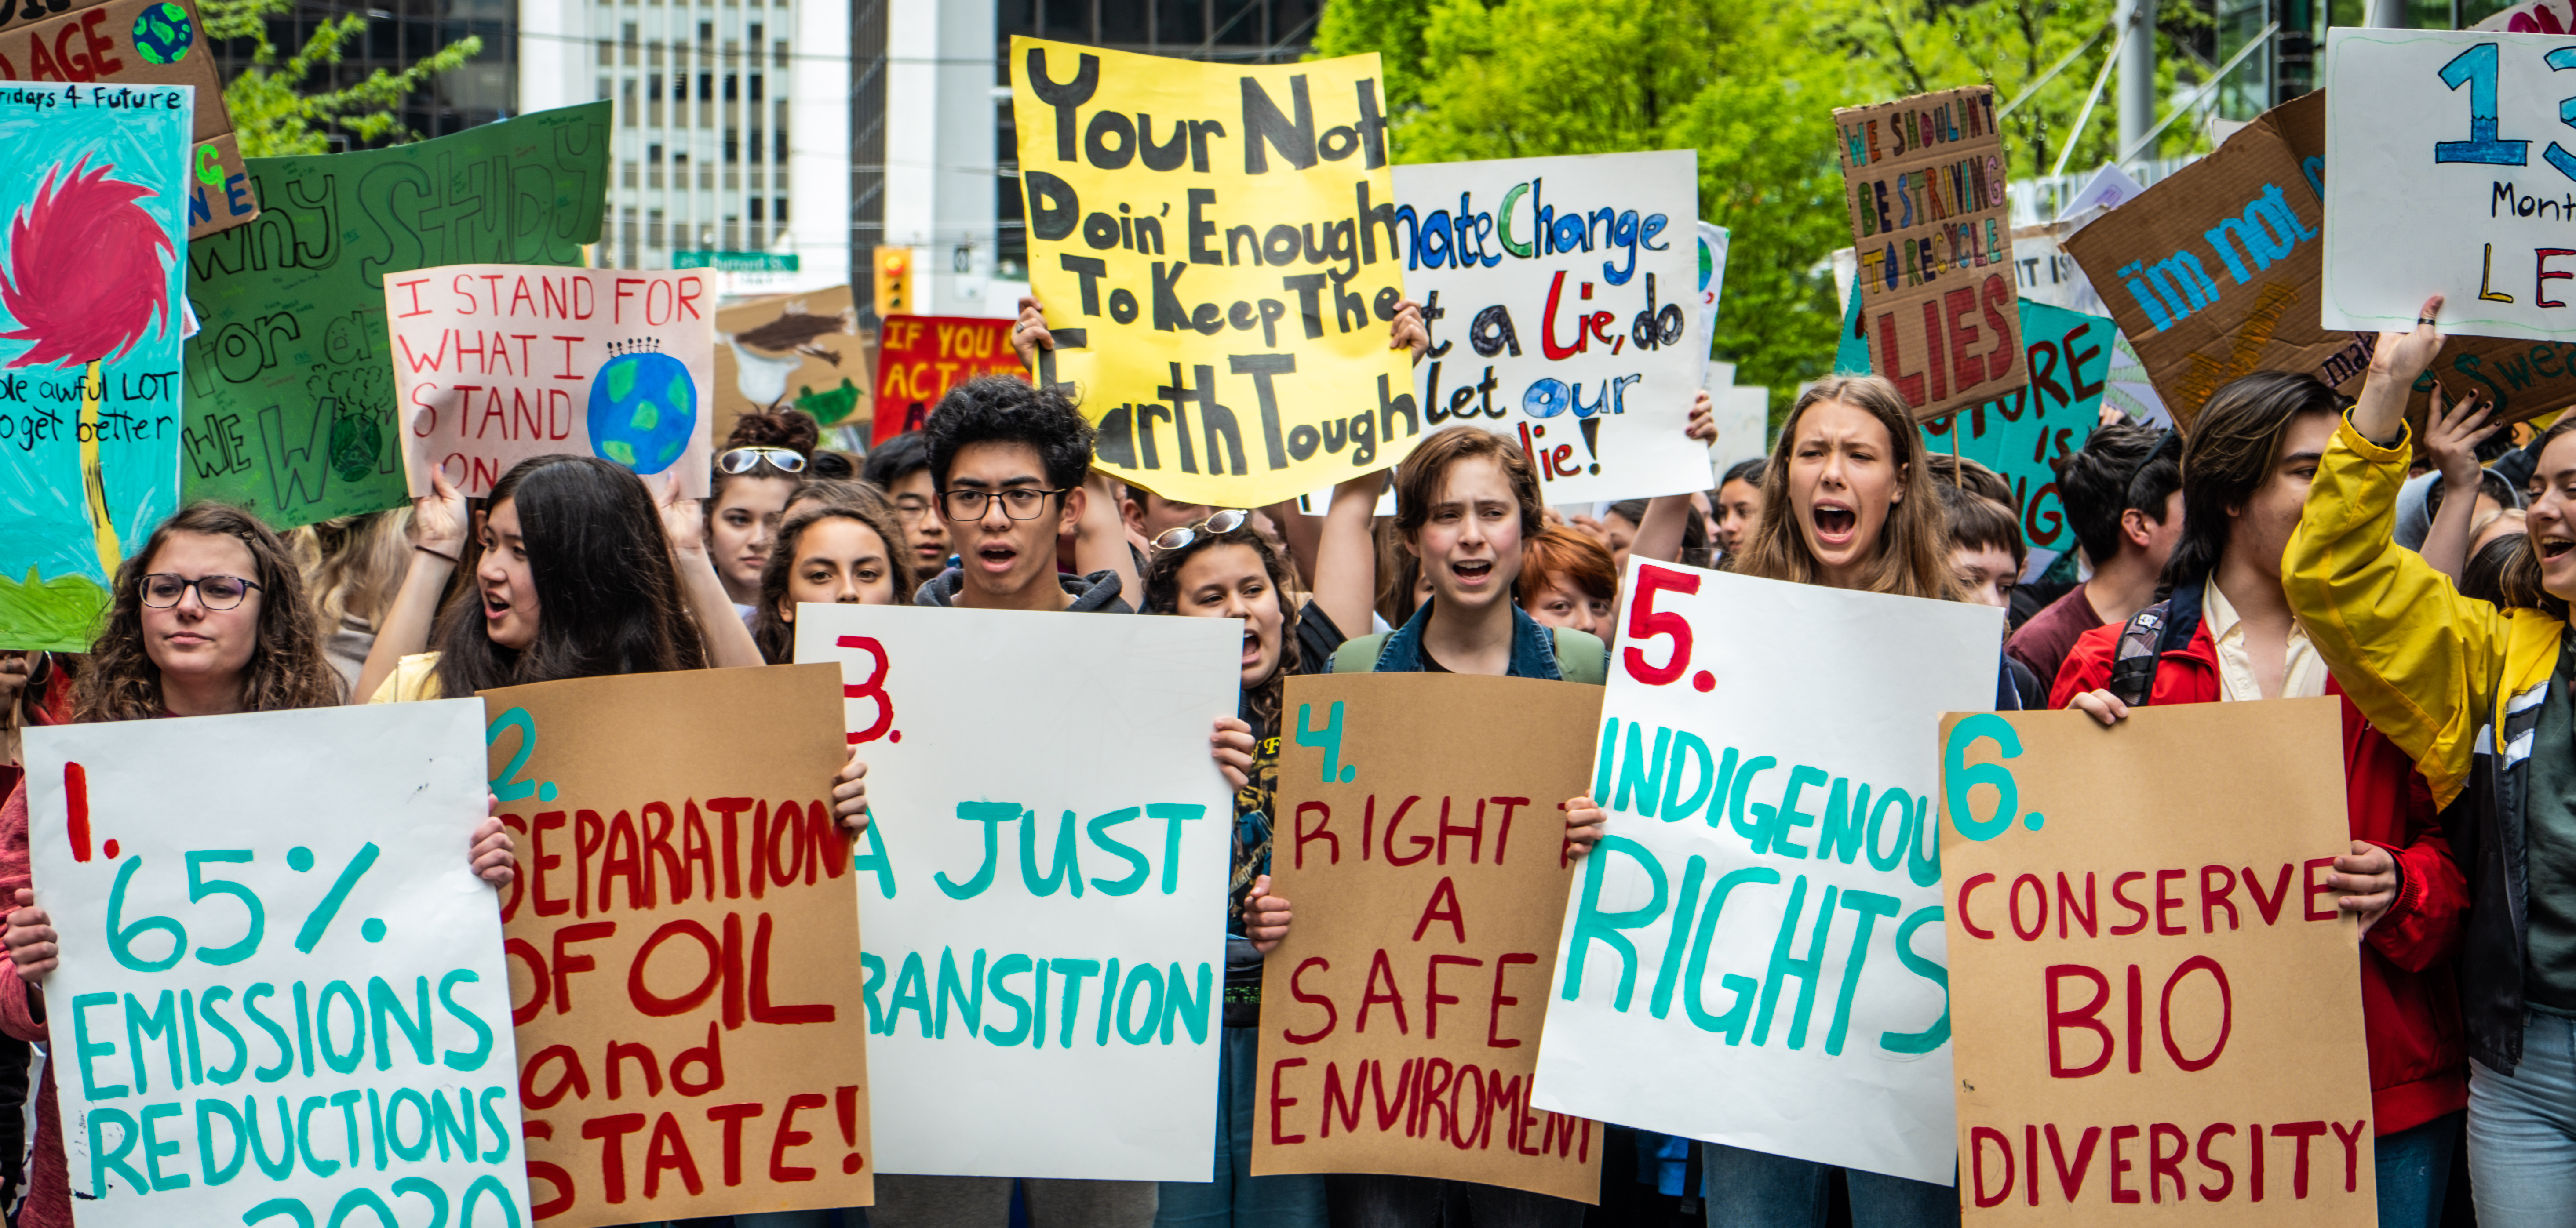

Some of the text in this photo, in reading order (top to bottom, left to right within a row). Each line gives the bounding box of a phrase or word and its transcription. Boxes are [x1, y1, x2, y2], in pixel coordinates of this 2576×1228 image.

[30, 8, 124, 83] AGE
[0, 84, 182, 112] ridays 4 Future
[1027, 47, 1388, 175] Your Not
[1844, 90, 1995, 167] WE SHOULDN'T
[1025, 170, 1400, 282] Doin' Enough
[1498, 176, 1670, 287] Change
[1858, 180, 1893, 237] BE
[1898, 155, 2003, 230] STRIVING
[2204, 182, 2318, 286] not
[2492, 181, 2576, 222] Mont
[396, 274, 703, 326] I STAND FOR
[1060, 253, 1401, 348] To Keep The
[1862, 218, 2003, 294] TO RECYCLE
[2478, 243, 2576, 308] LE
[397, 328, 585, 380] WHAT I
[884, 321, 924, 351] IF
[936, 323, 995, 359] YOU
[1469, 305, 1522, 358] a
[1542, 270, 1626, 361] Lie,
[1632, 272, 1684, 351] do
[1877, 272, 2015, 409] LIES
[39, 371, 108, 403] awful
[123, 371, 178, 402] LOT
[412, 382, 572, 441] STAND
[883, 363, 959, 401] ACT
[1228, 353, 1420, 471] Tough
[1425, 361, 1642, 426] let our
[2454, 344, 2576, 415] Swe
[18, 405, 64, 451] get
[75, 407, 173, 443] better
[182, 414, 251, 478] WE
[443, 453, 498, 493] ON
[2035, 426, 2073, 472] IS
[1624, 564, 1716, 693] 5.
[836, 634, 902, 745] 3.
[486, 706, 558, 802] 2.
[1295, 701, 1356, 783] 4.
[1945, 713, 2044, 841] 6.
[64, 761, 120, 863] 1.
[1294, 794, 1530, 870] RIGHT
[1595, 717, 1942, 888] INDIGENOU
[499, 797, 854, 924] SEPARATION
[854, 806, 897, 900] A
[933, 800, 1207, 900] JUST
[106, 842, 387, 973] 65%
[1412, 876, 1466, 944] A
[1958, 856, 2339, 942] CONSERVE
[503, 912, 836, 1031] OF OIL
[1562, 834, 1952, 1057] RIGHTS
[72, 968, 494, 1101] EMISSIONS
[862, 945, 1213, 1049] RANSITION
[1284, 948, 1538, 1048] SAFE
[2045, 955, 2232, 1078] BIO
[519, 1021, 724, 1111] and
[87, 1086, 510, 1199] REDUCTIONS
[522, 1085, 864, 1222] STATE!
[1971, 1119, 2366, 1207] DIVERSITY
